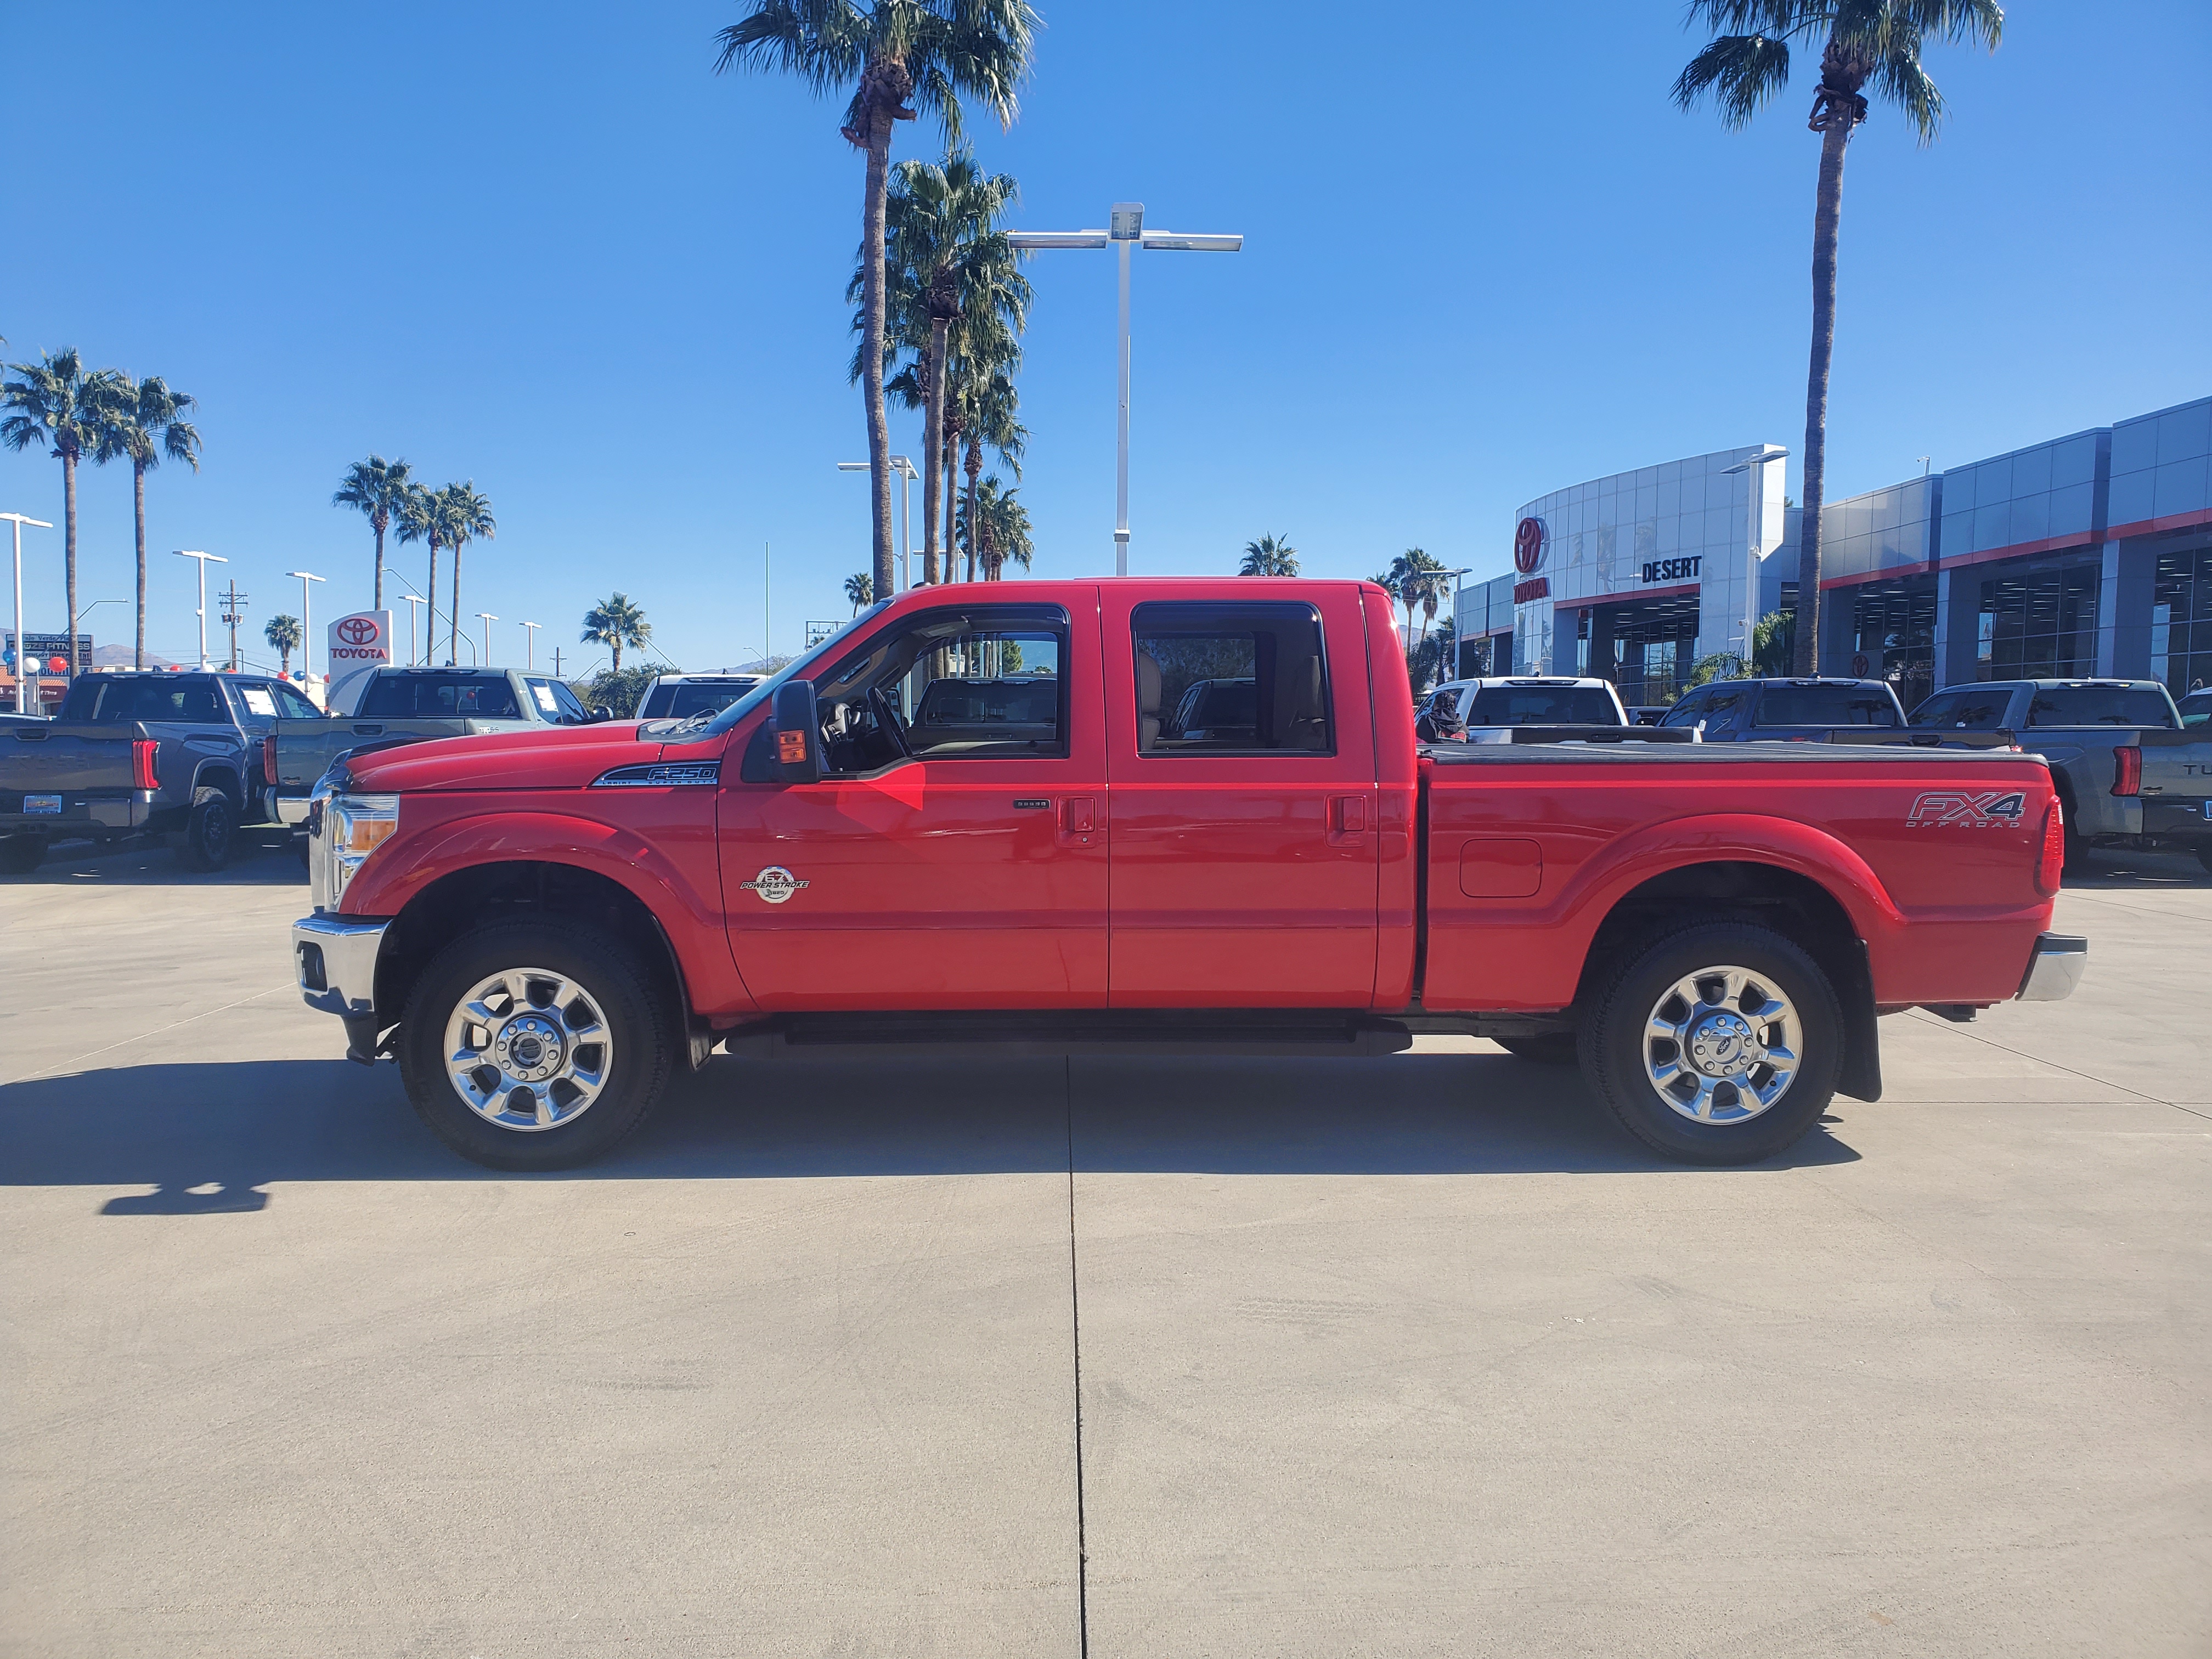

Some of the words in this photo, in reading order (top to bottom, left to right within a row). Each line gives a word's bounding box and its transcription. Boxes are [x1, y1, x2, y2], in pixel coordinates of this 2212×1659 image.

[1642, 556, 1702, 583] DESERT
[1514, 577, 1547, 604] TOYOTA
[330, 648, 387, 658] TOYOTA
[647, 768, 716, 780] F-250
[1908, 792, 2027, 820] FX4
[1719, 1039, 1729, 1052] Ford
